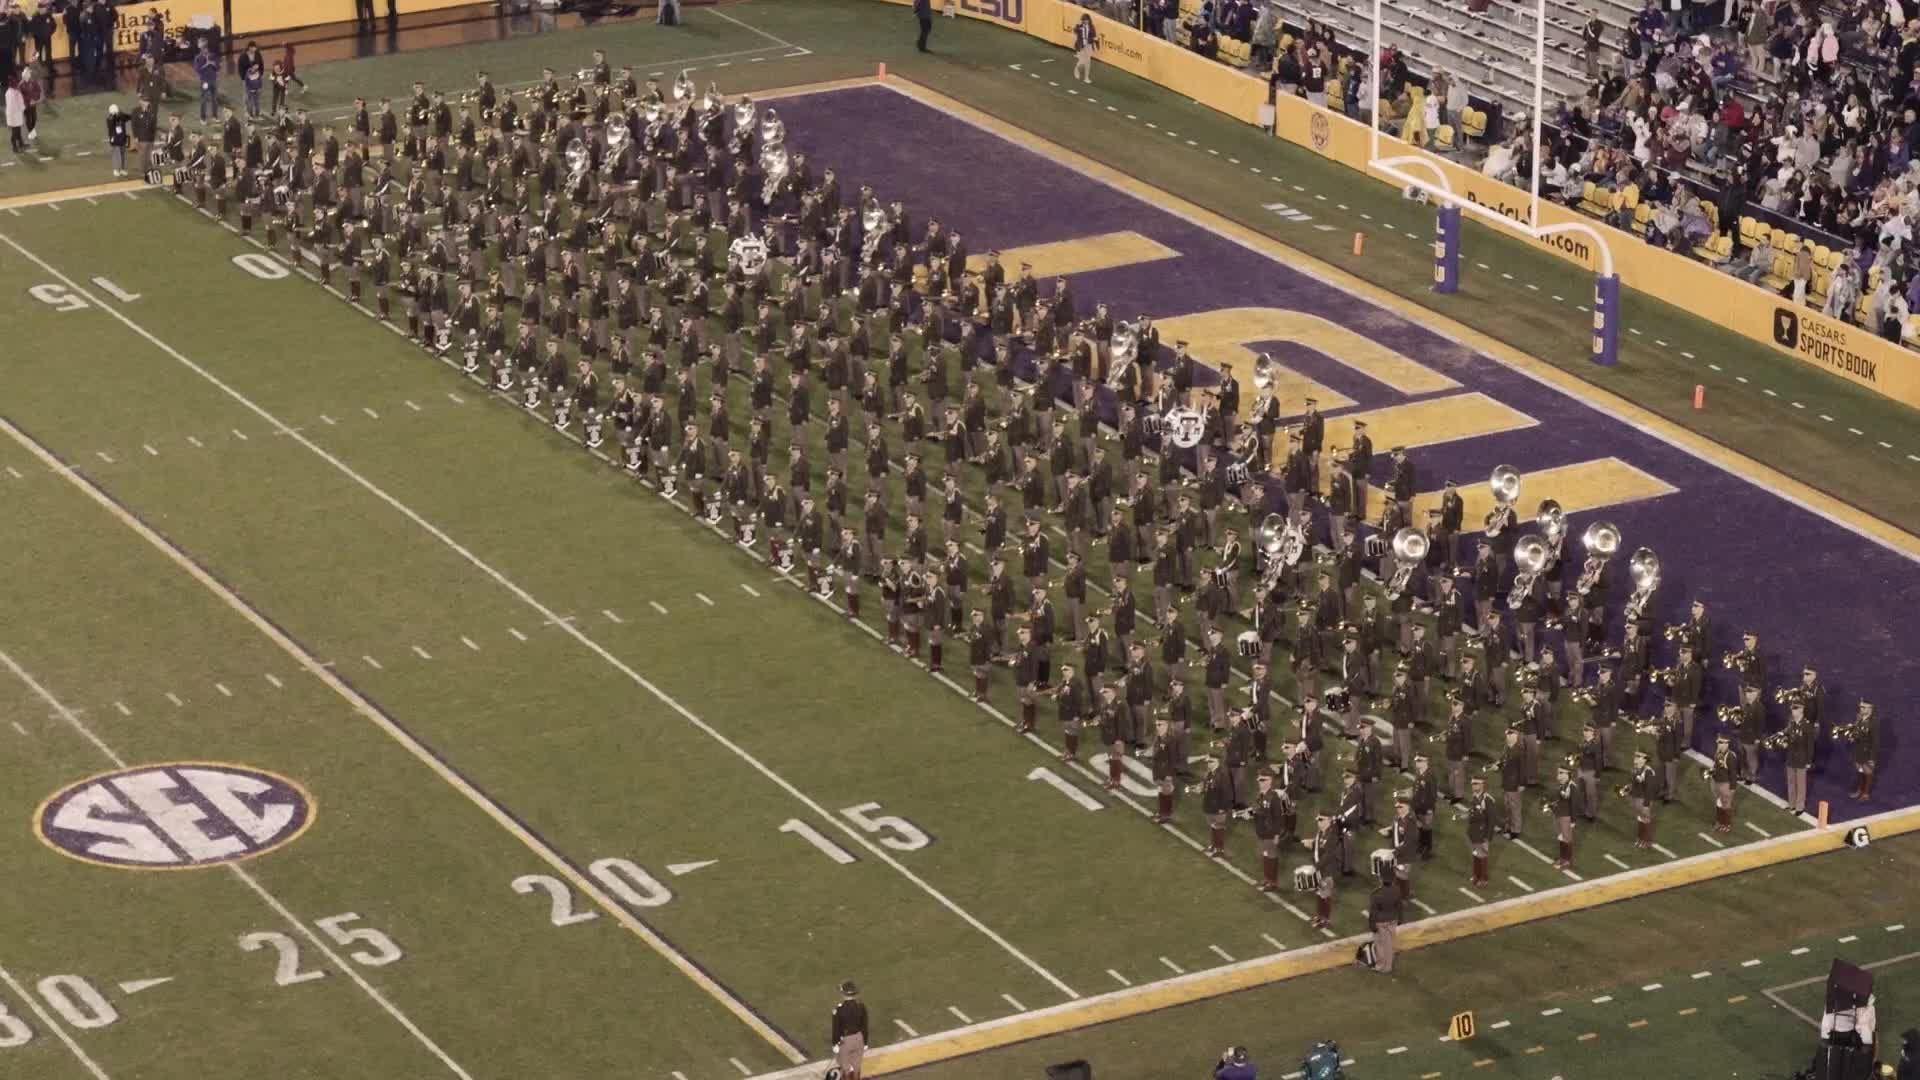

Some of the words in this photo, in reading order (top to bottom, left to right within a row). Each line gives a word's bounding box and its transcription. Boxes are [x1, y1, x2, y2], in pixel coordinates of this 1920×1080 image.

[117, 26, 185, 46] fitss
[1800, 316, 1847, 346] CAESARS
[1800, 333, 1877, 382] SPORTSBOOK
[52, 767, 296, 864] SEC
[777, 801, 933, 865] 15
[1853, 827, 1870, 848] G
[510, 857, 673, 927] 20
[238, 911, 403, 986] 25
[1456, 1014, 1472, 1038] 10
